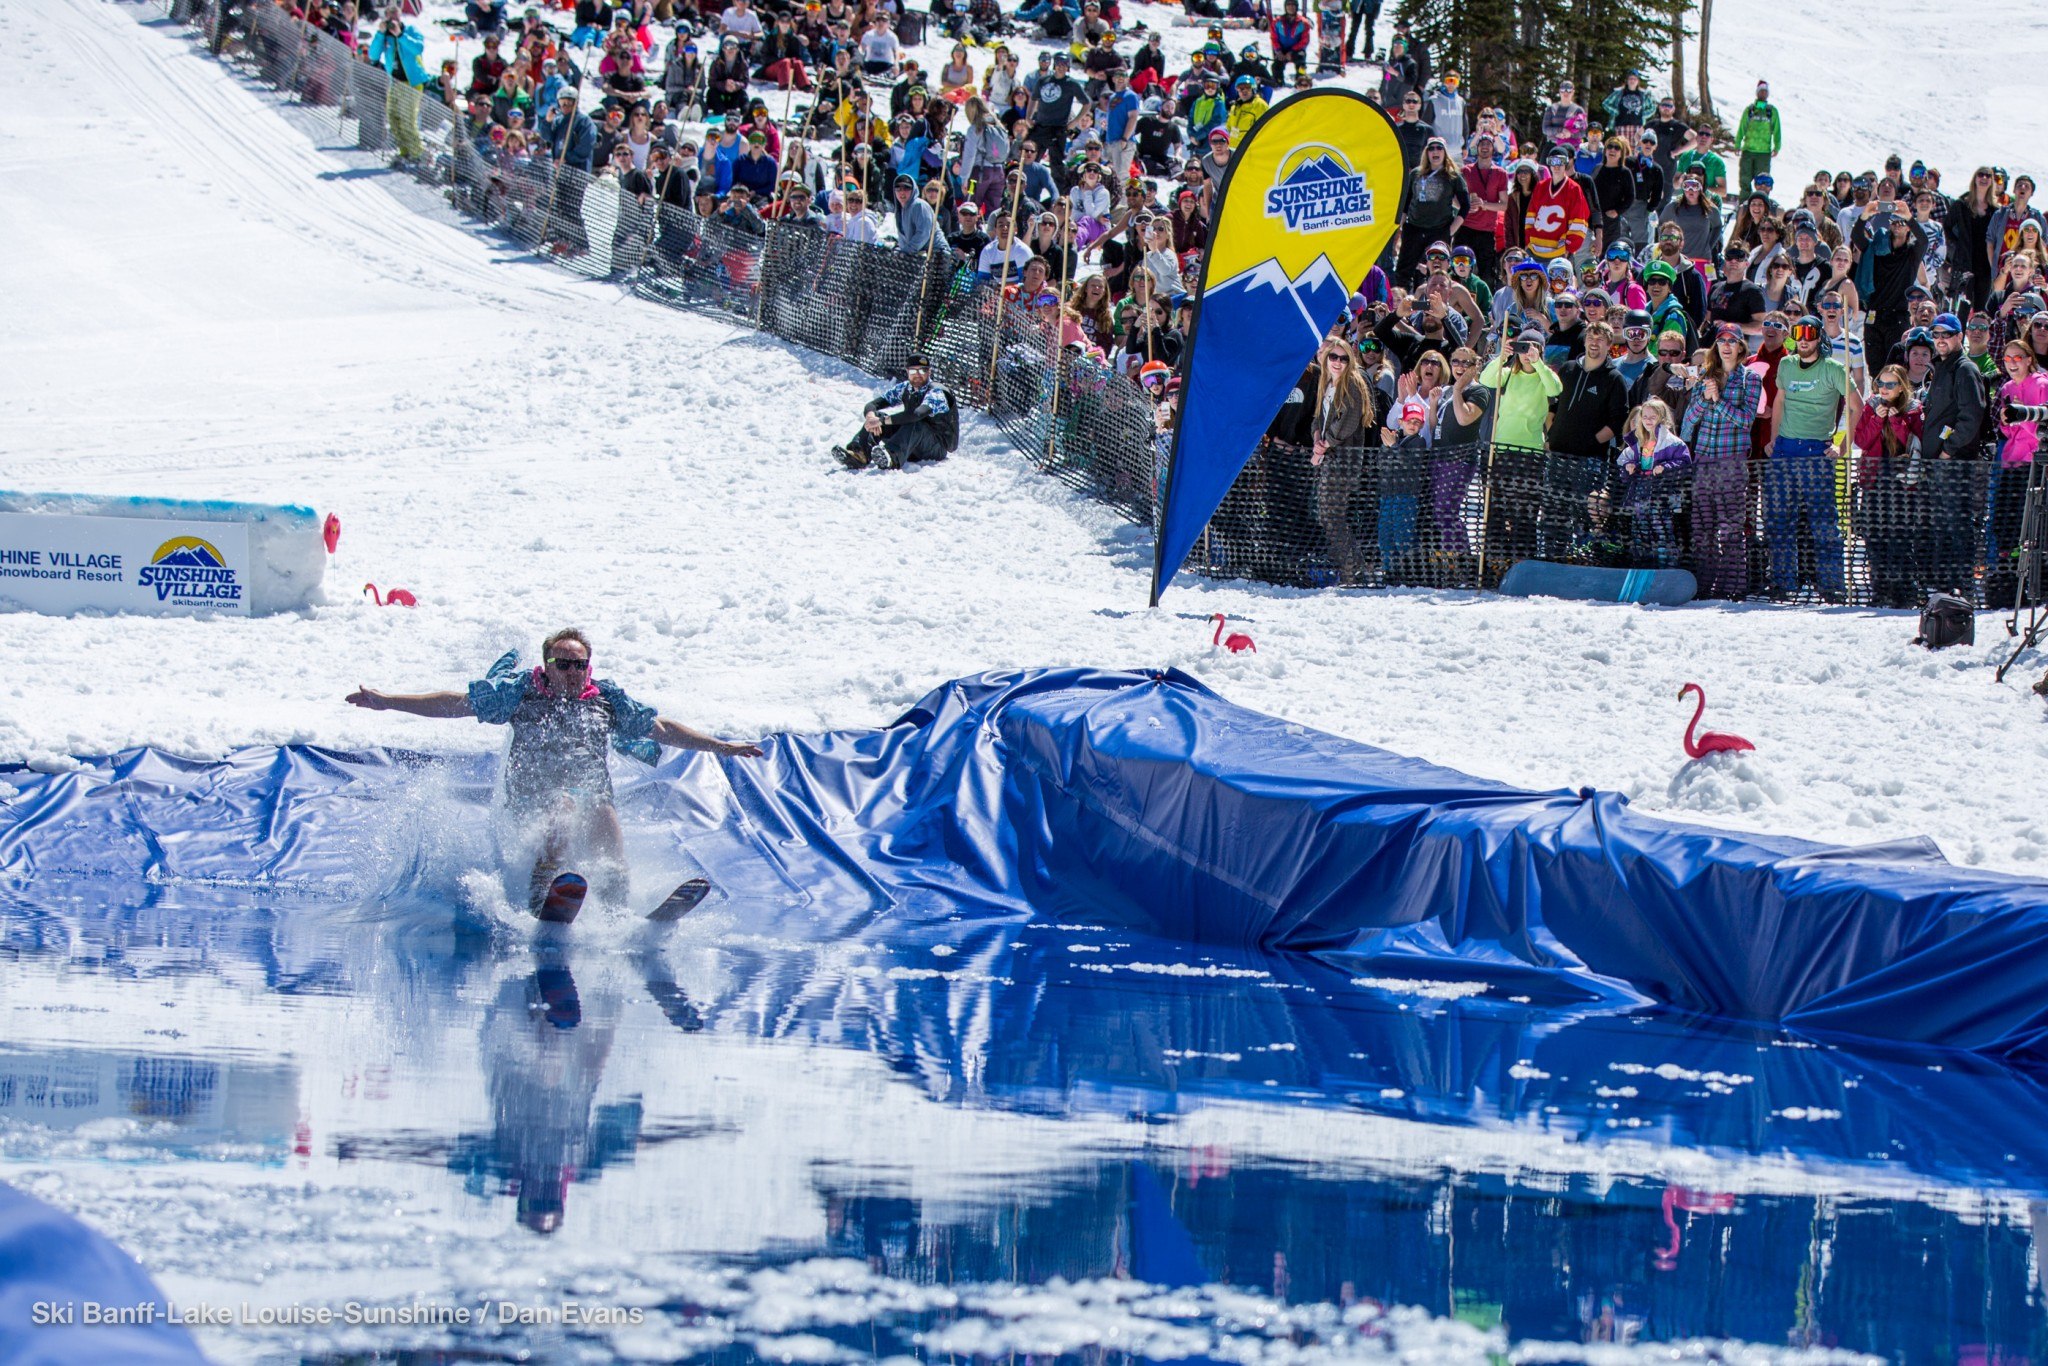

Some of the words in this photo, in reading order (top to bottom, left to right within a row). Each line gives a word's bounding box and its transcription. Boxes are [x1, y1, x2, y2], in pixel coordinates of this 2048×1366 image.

[1268, 177, 1363, 214] SUNSHINE
[1284, 194, 1371, 228] VILLAGE
[1303, 219, 1329, 231] Banff
[1334, 214, 1372, 226] Canada
[49, 552, 122, 569] VILLAGE
[77, 569, 123, 582] Resort
[138, 566, 236, 587] SUNSHINE
[154, 581, 242, 600] VILLAGE
[172, 599, 238, 609] skibanff.com
